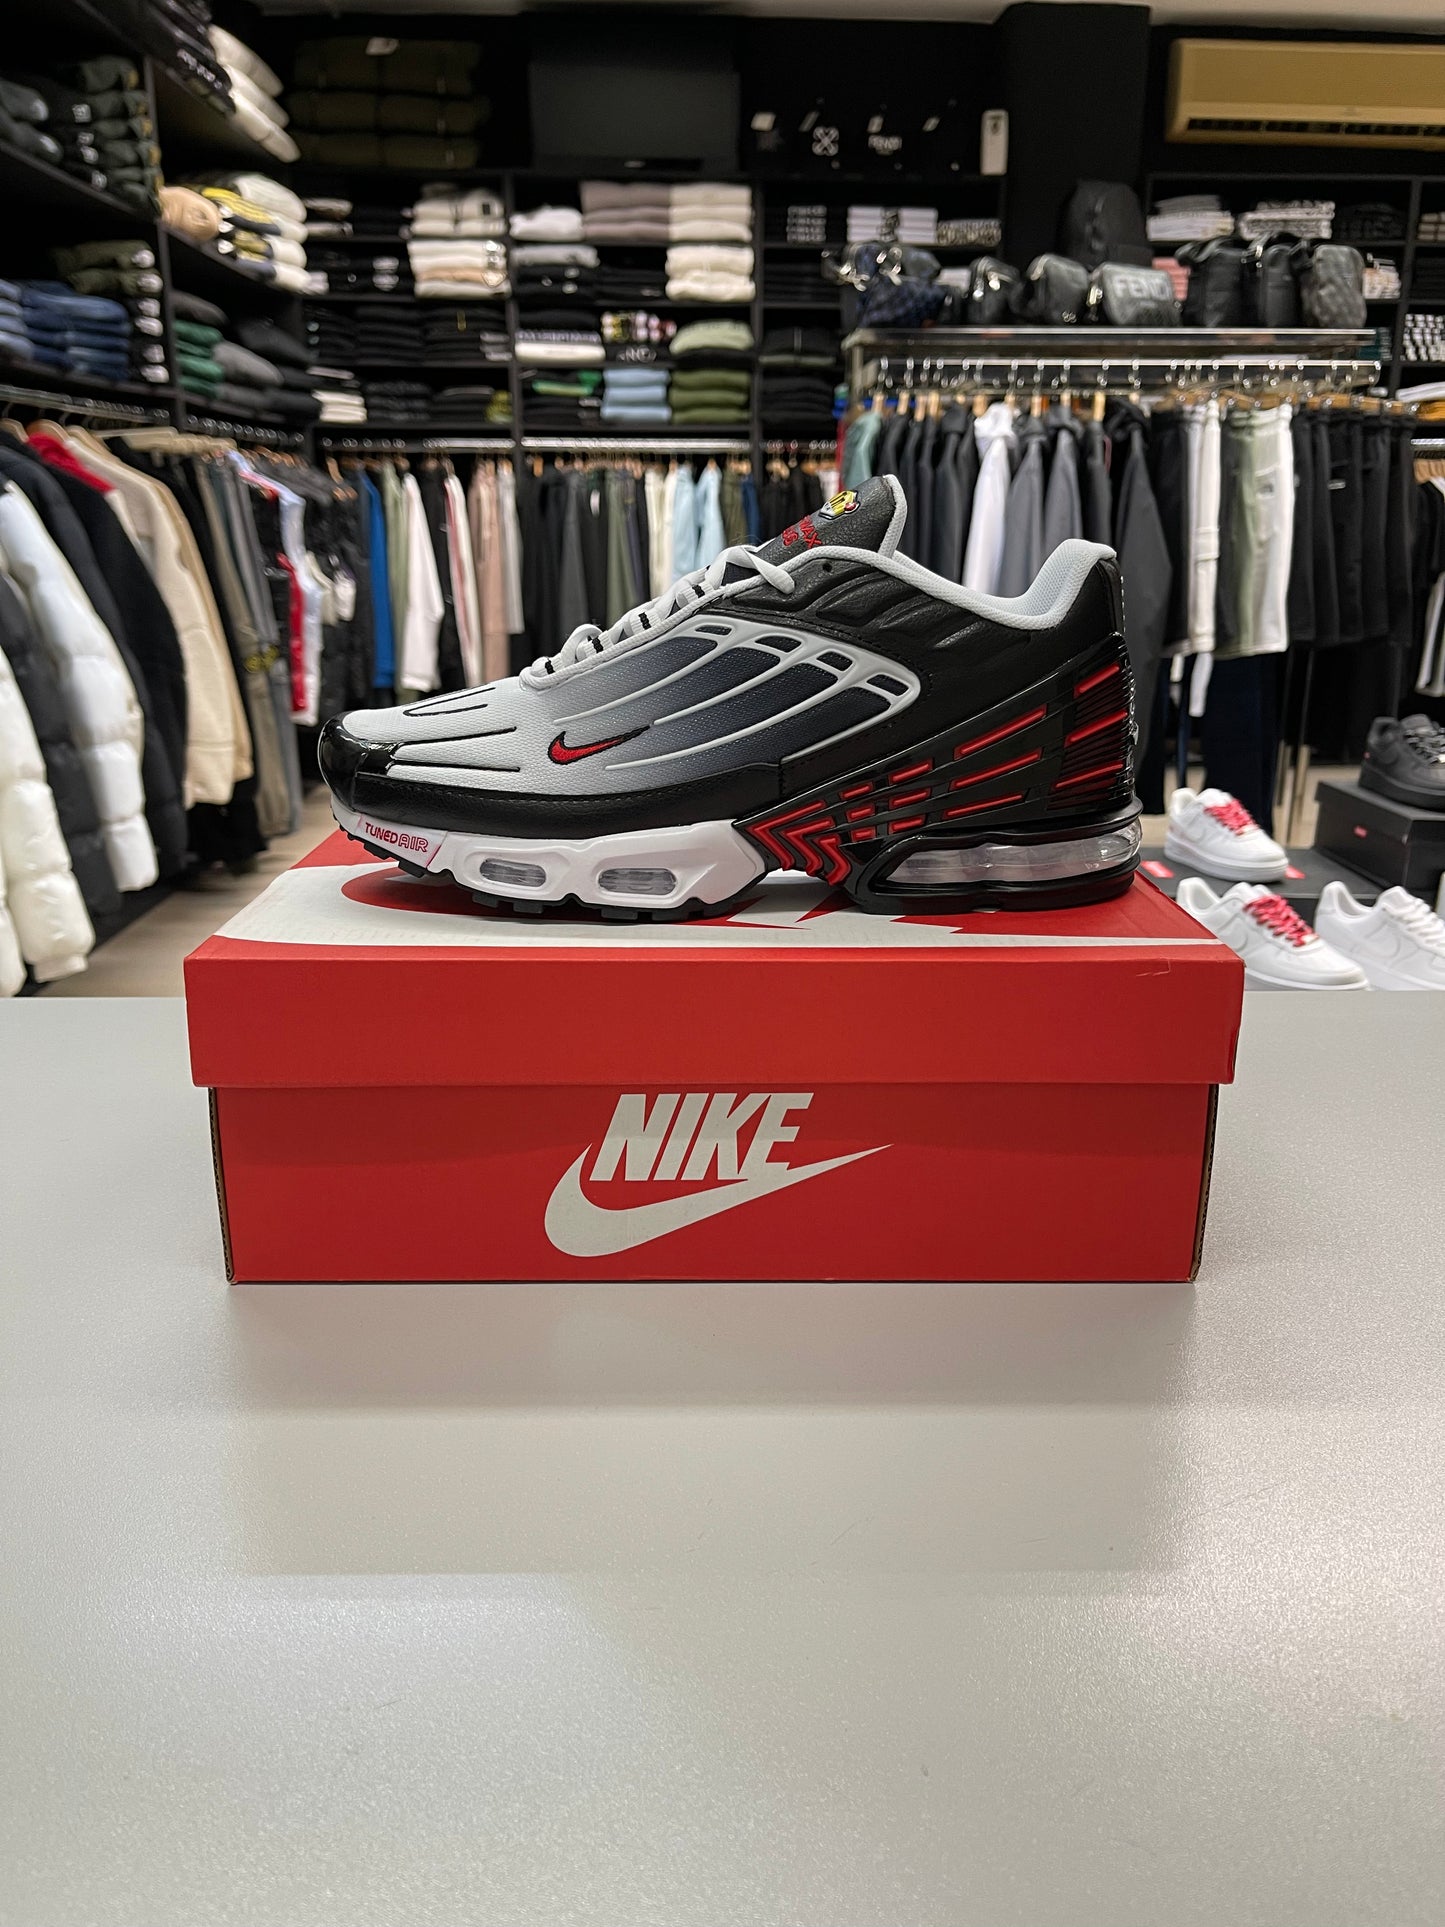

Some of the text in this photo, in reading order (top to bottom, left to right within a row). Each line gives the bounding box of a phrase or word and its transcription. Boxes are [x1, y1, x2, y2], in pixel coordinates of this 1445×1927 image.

[365, 822, 428, 852] TUNED AIR
[590, 1092, 814, 1181] NIKE
